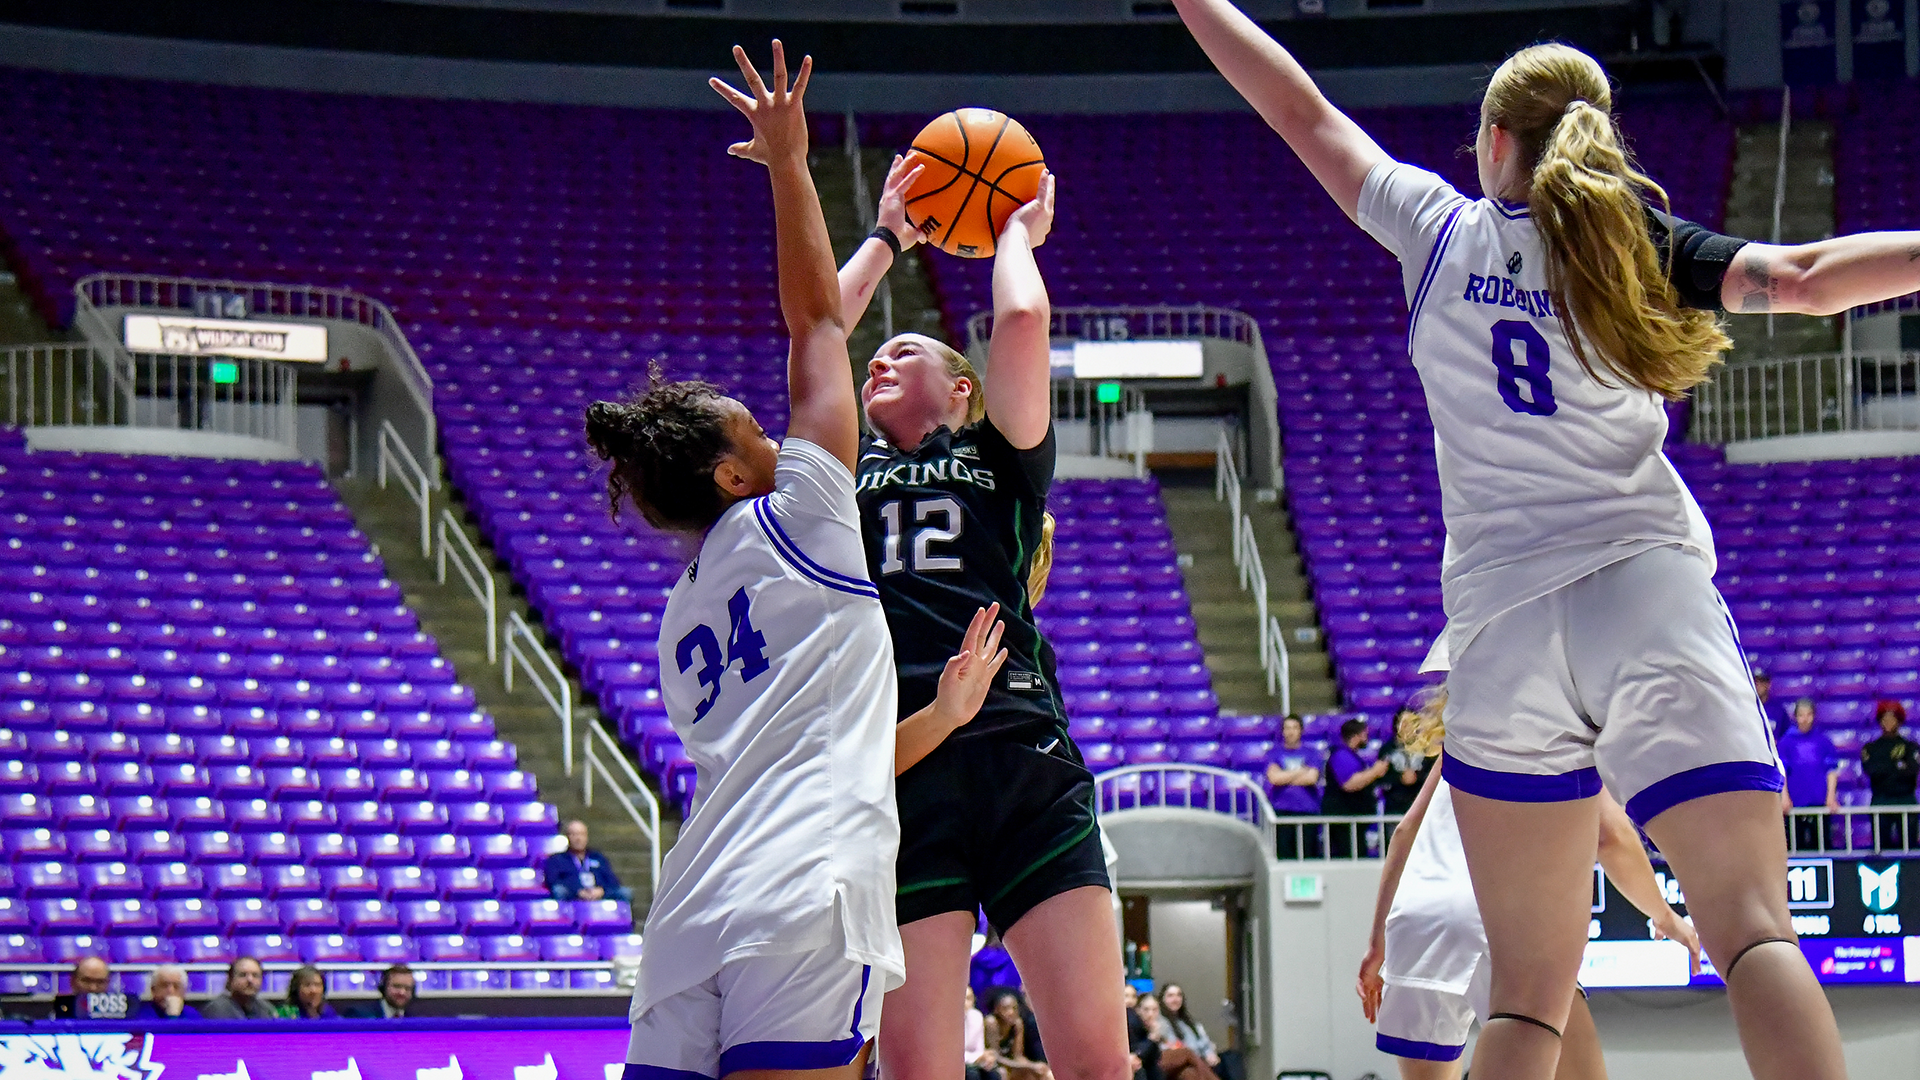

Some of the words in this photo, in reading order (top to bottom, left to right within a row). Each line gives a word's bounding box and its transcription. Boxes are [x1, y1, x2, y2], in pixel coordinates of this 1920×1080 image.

[1463, 272, 1559, 318] ROBBIN
[1490, 319, 1558, 417] 8
[879, 497, 964, 575] 12
[676, 586, 770, 724] 34
[87, 992, 128, 1013] POSS
